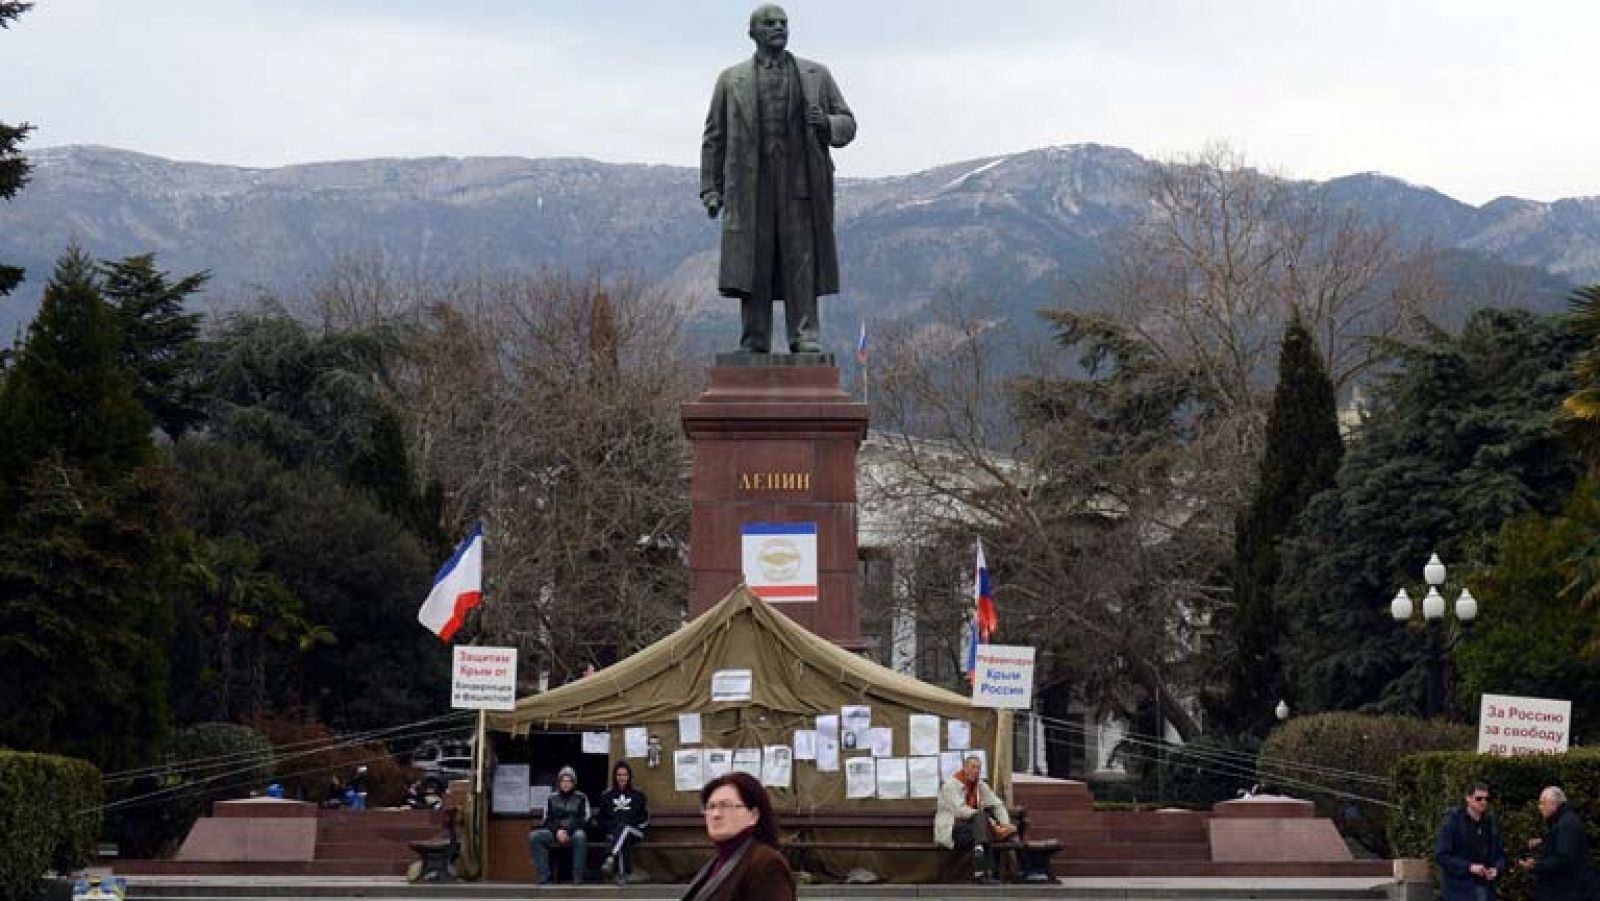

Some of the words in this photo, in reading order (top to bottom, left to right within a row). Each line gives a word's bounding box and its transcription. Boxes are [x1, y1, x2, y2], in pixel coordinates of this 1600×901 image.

[738, 472, 810, 491] ЛЕНИН
[460, 664, 492, 677] Крым
[495, 667, 507, 677] от
[986, 668, 1021, 682] Крым
[980, 683, 1024, 696] Россия
[1486, 704, 1505, 719] За
[1508, 706, 1564, 724] Россию
[1484, 725, 1499, 735] за
[1503, 725, 1564, 744] свободу
